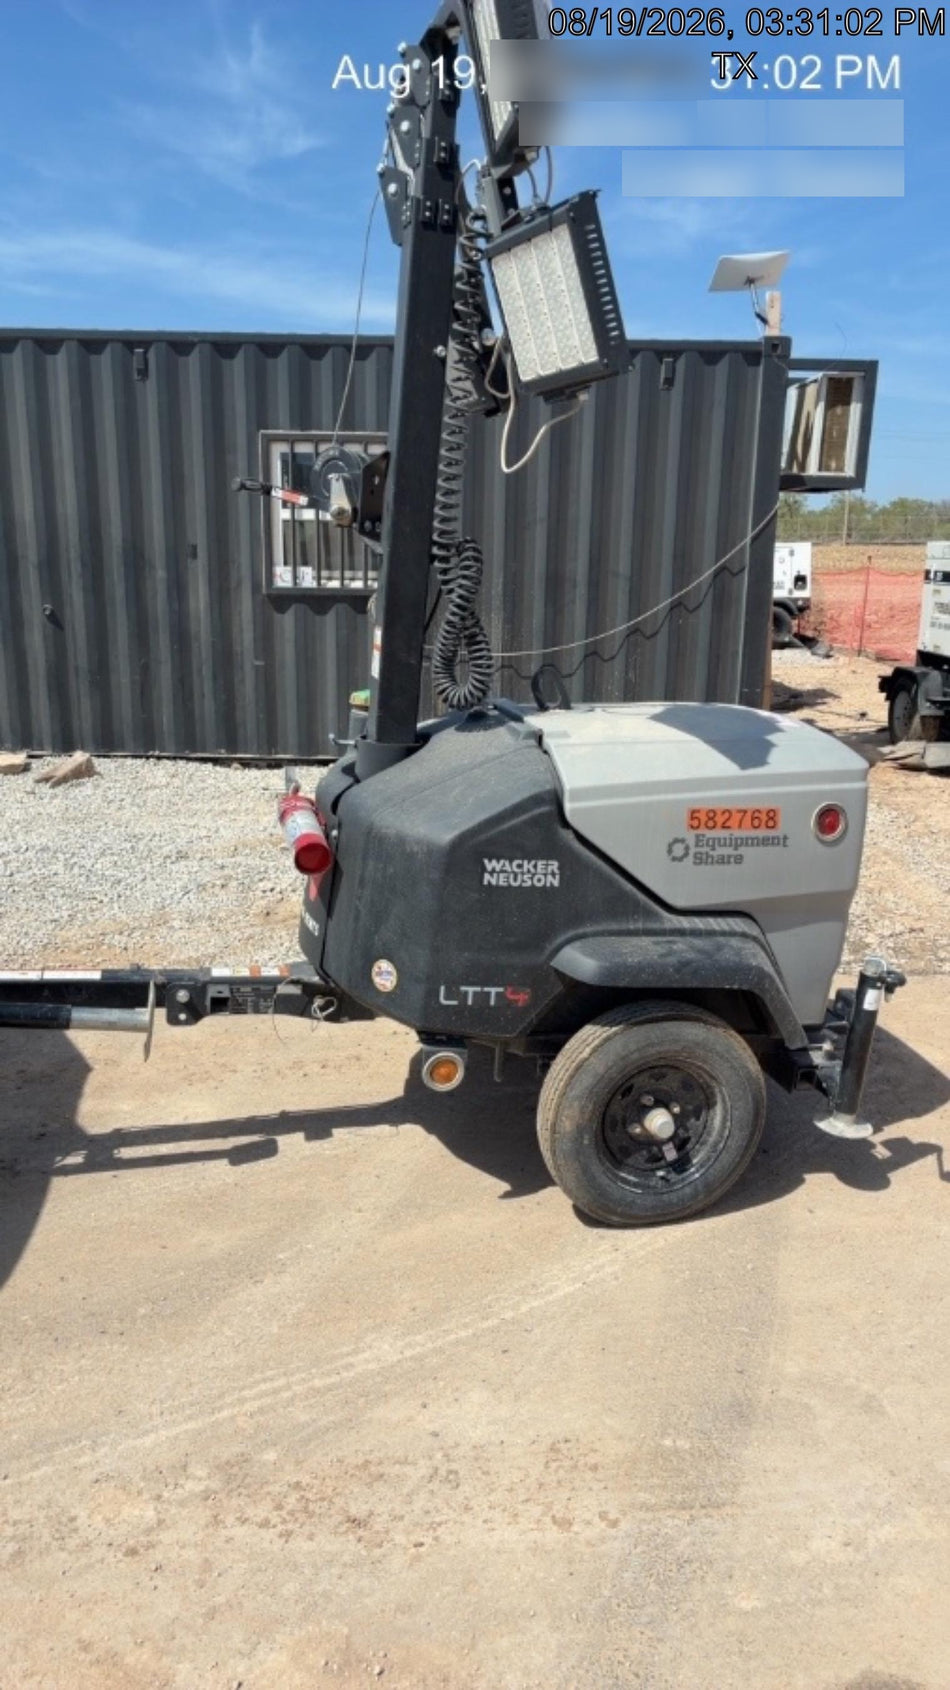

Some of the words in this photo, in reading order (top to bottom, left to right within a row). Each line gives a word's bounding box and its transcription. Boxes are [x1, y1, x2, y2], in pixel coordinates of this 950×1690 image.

[689, 808, 777, 830] 582768
[694, 833, 790, 851] Equipment
[482, 858, 560, 874] WACKER
[692, 851, 745, 866] Share
[482, 873, 560, 888] NEUSON
[439, 983, 532, 1007] LTT4
